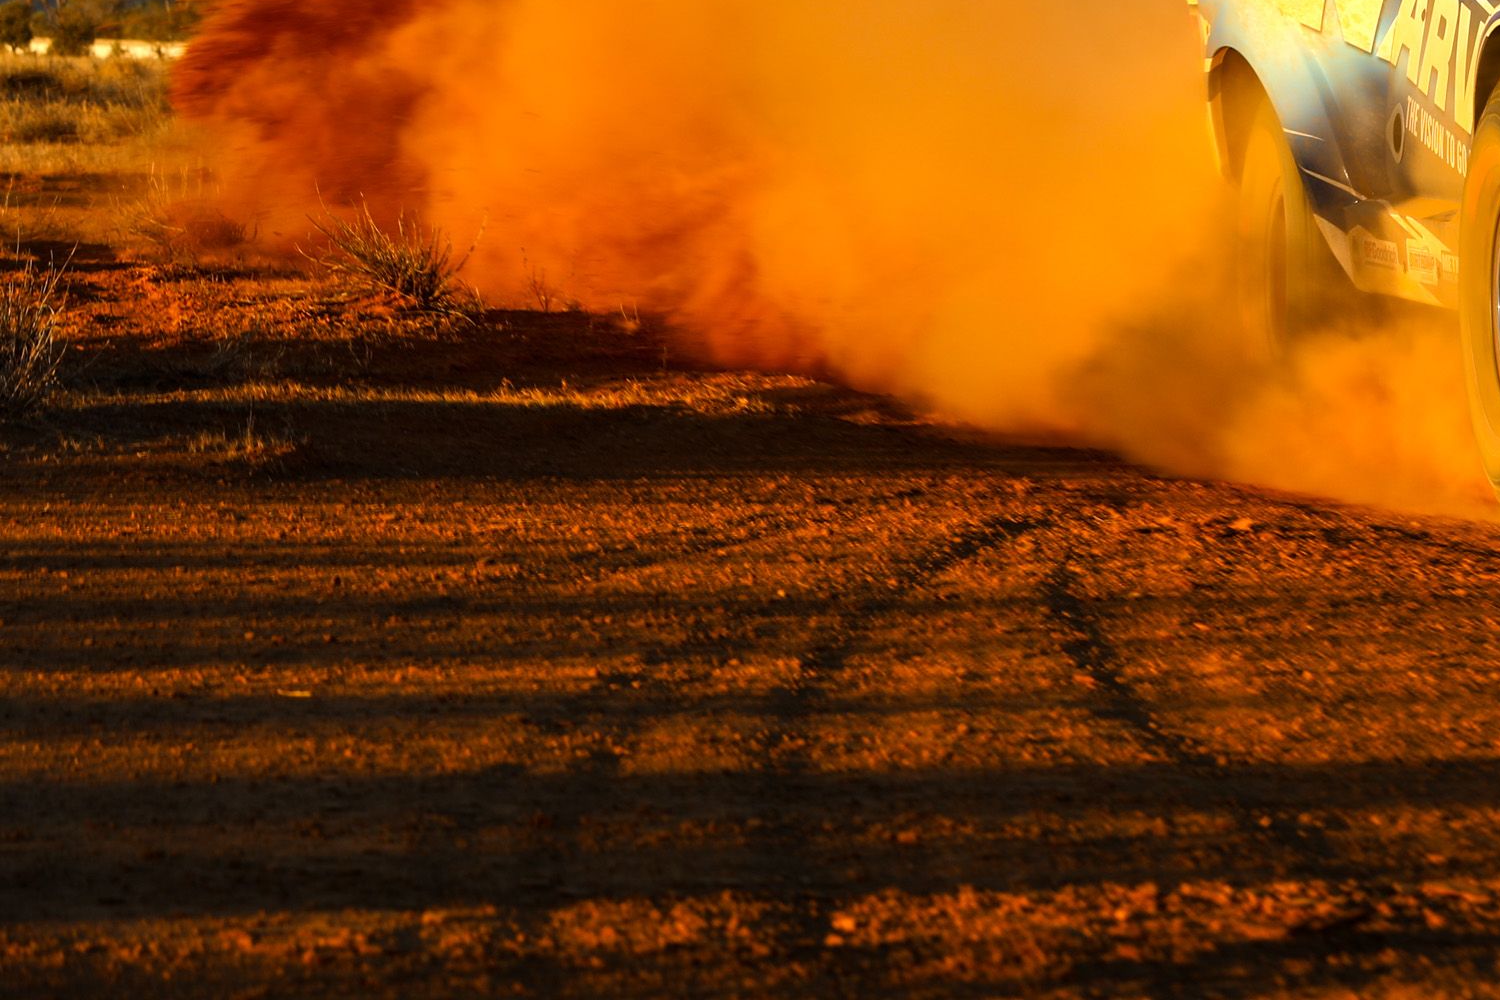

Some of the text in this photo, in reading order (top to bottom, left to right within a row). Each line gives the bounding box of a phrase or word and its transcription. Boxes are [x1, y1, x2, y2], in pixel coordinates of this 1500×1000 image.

[1406, 95, 1468, 178] THE VISION TO GO
